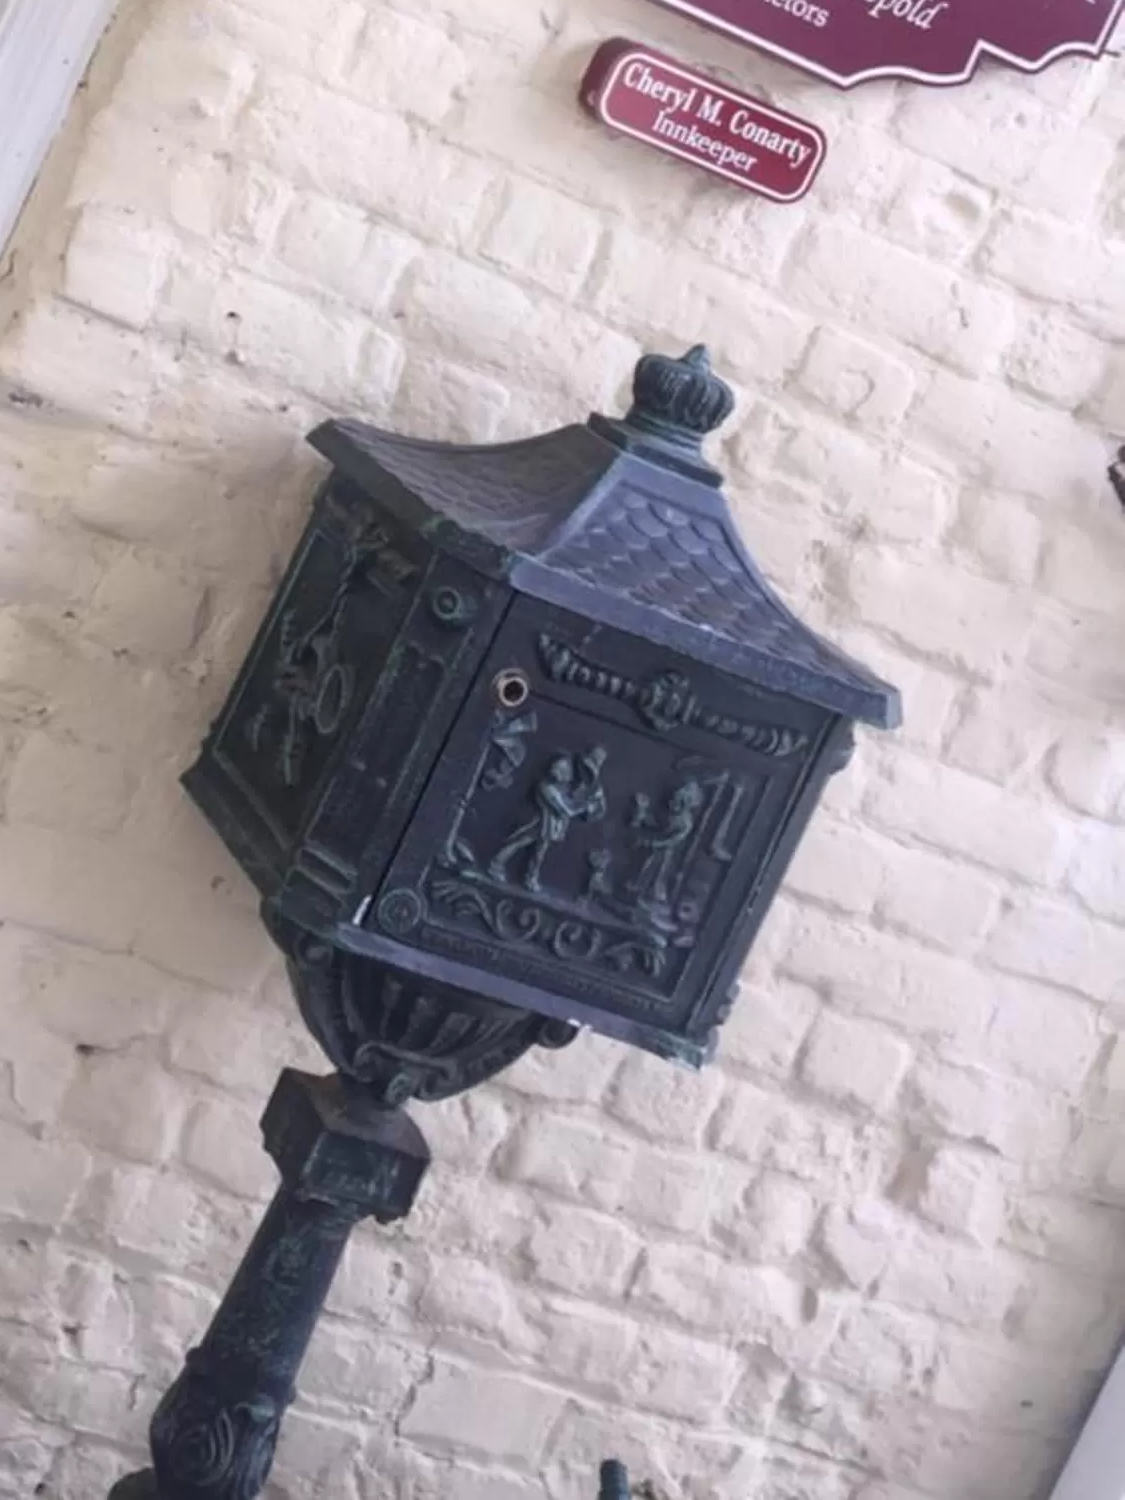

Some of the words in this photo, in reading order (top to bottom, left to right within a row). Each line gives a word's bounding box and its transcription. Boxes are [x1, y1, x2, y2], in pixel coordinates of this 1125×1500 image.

[624, 62, 698, 113] Cheryl
[696, 95, 725, 127] M.
[729, 109, 812, 169] Conarty
[652, 111, 758, 173] Innkeeper
